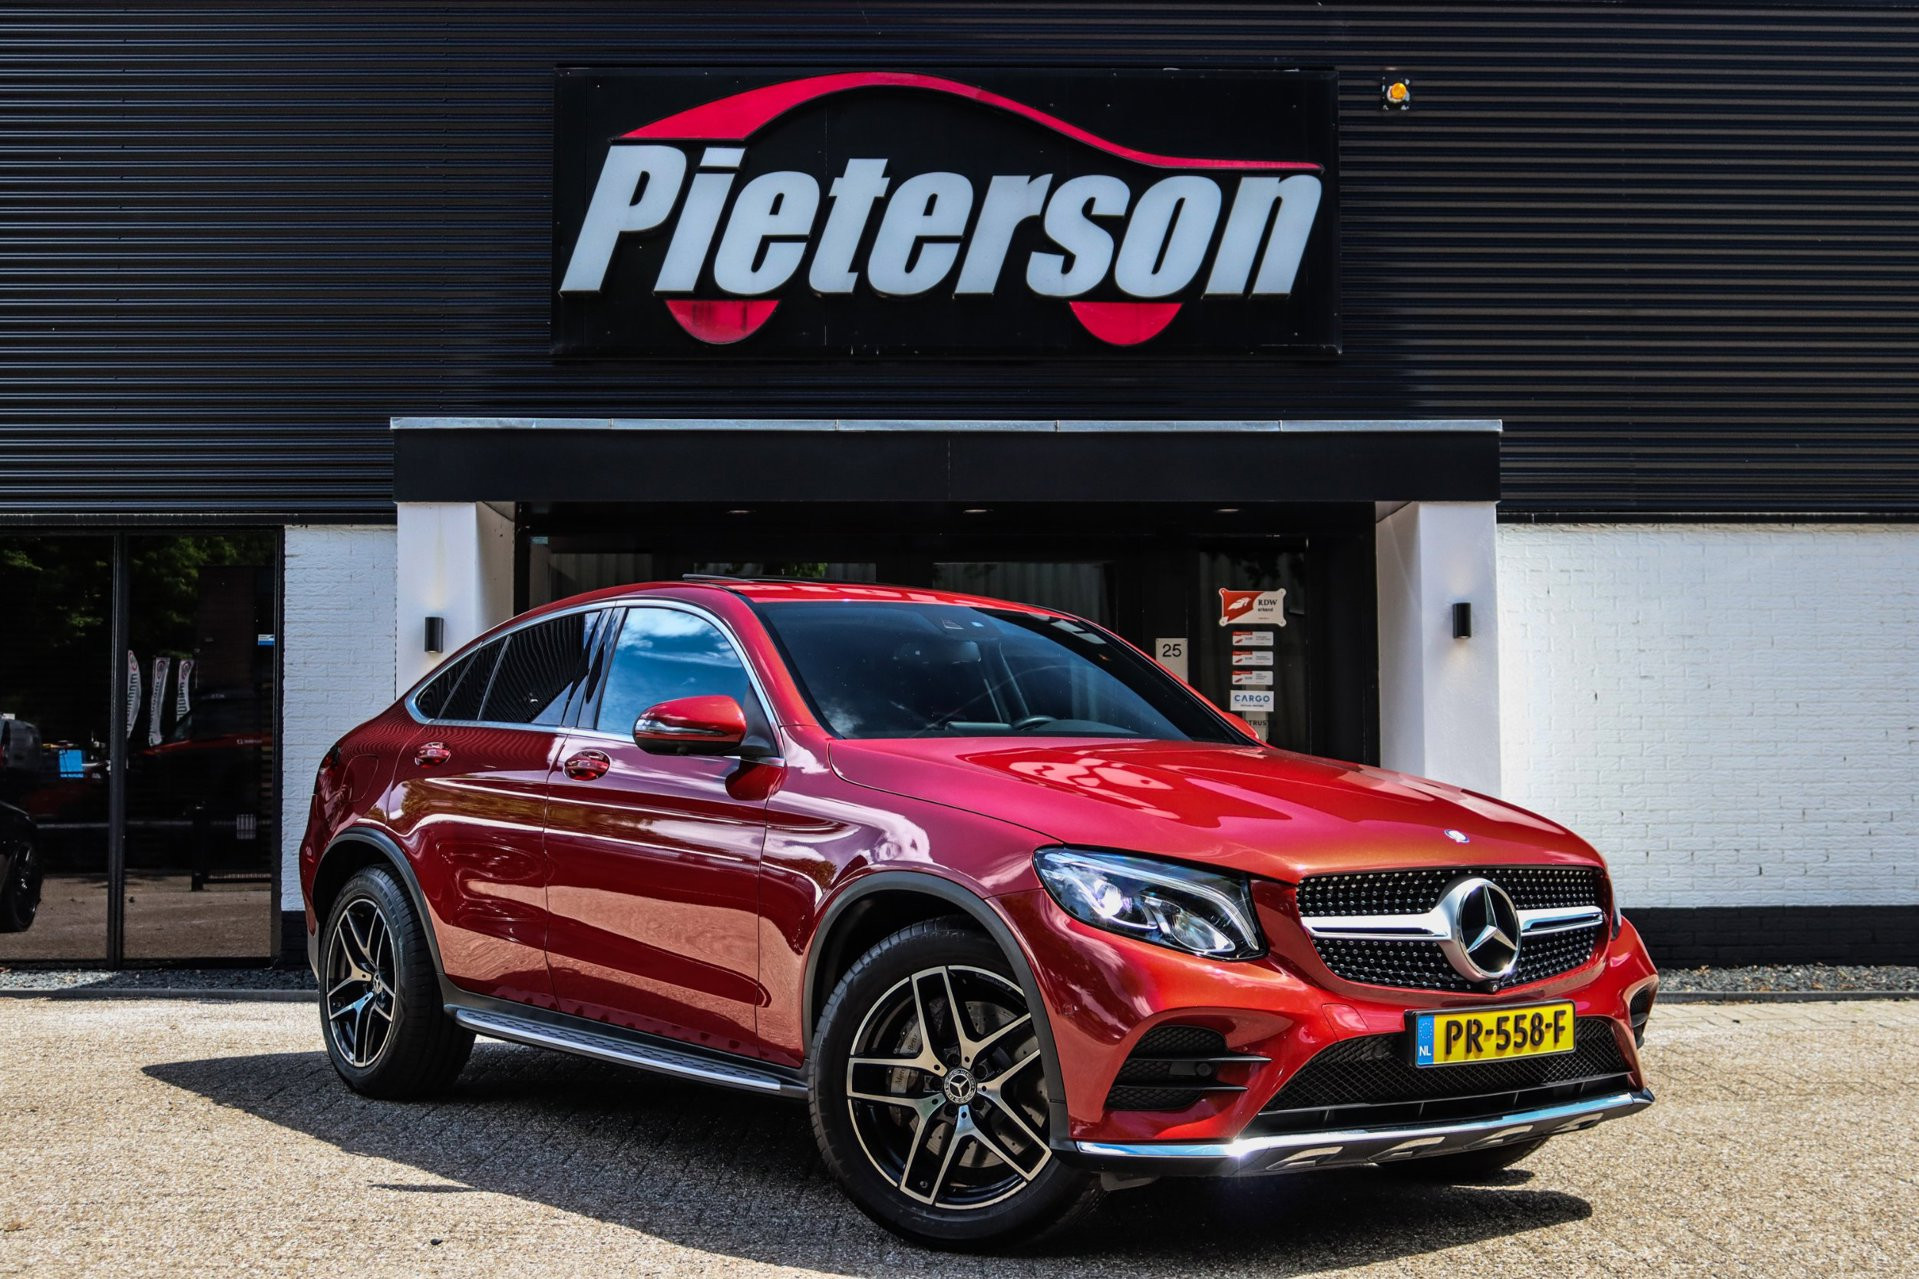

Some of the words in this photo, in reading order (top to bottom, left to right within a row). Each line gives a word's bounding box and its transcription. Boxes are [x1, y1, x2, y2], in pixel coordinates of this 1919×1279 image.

[559, 144, 1322, 299] Pieterson
[1162, 643, 1182, 657] 25
[1234, 694, 1271, 703] CARGO
[1445, 1009, 1567, 1055] PR-558-F
[1419, 1045, 1432, 1057] NL
